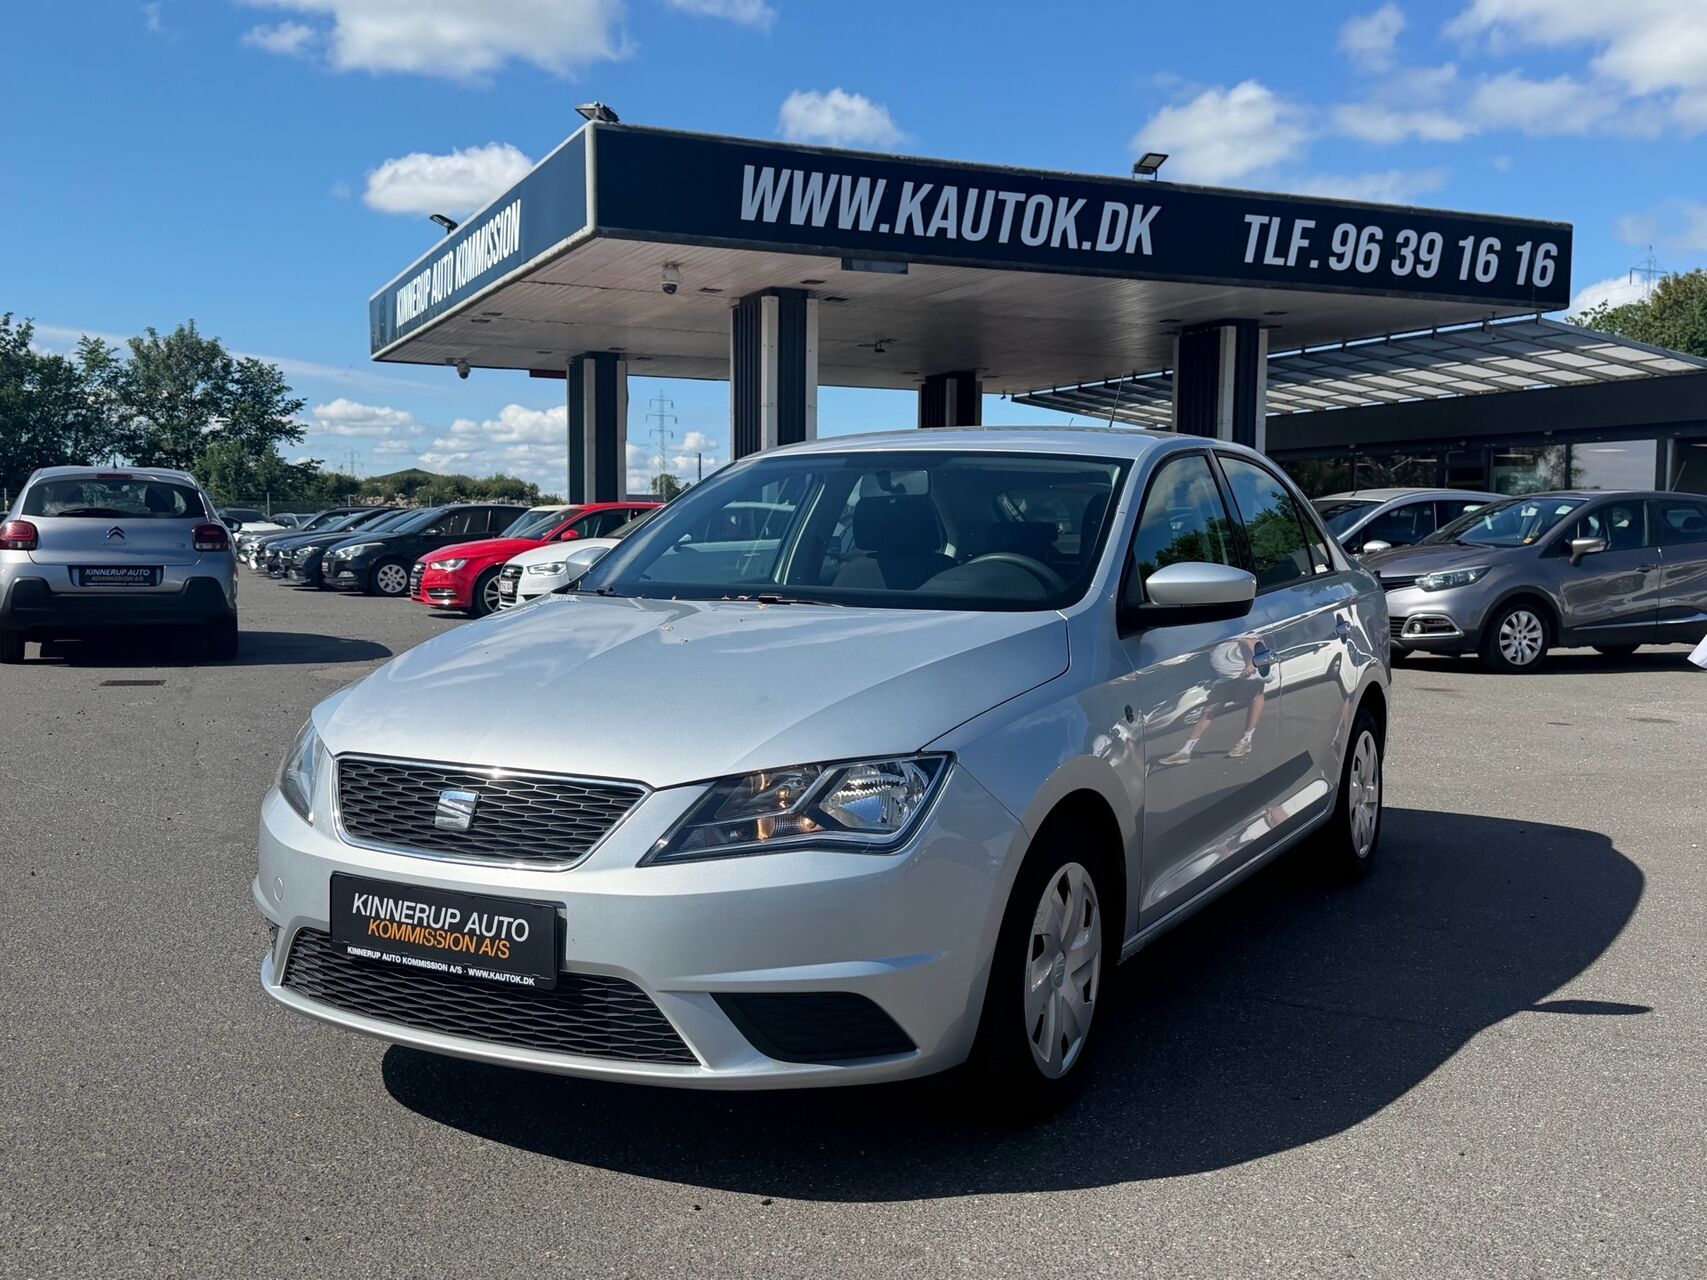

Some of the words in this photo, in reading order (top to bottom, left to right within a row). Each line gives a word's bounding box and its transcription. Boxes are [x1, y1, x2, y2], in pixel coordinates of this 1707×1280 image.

[740, 164, 1161, 256] WWW.KAUTOK.DK
[396, 268, 431, 328] KINNERUP
[431, 250, 454, 306] AUTO
[455, 199, 521, 290] KOMMISSION
[1244, 214, 1319, 269] TLF.
[1328, 223, 1383, 274] 96
[1391, 229, 1444, 279] 39
[1458, 235, 1501, 283] 16
[1515, 241, 1558, 288] 16
[352, 893, 461, 930] KINNERUP
[464, 912, 530, 942] AUTO
[367, 919, 477, 953] KOMMISSION
[479, 938, 511, 959] A/S
[347, 946, 381, 959] KINNERUP
[382, 952, 401, 963] AUTO
[402, 957, 448, 972] KOMMISSION
[449, 964, 463, 974] A/S
[467, 967, 535, 986] WWW.KAUTOK.DK
